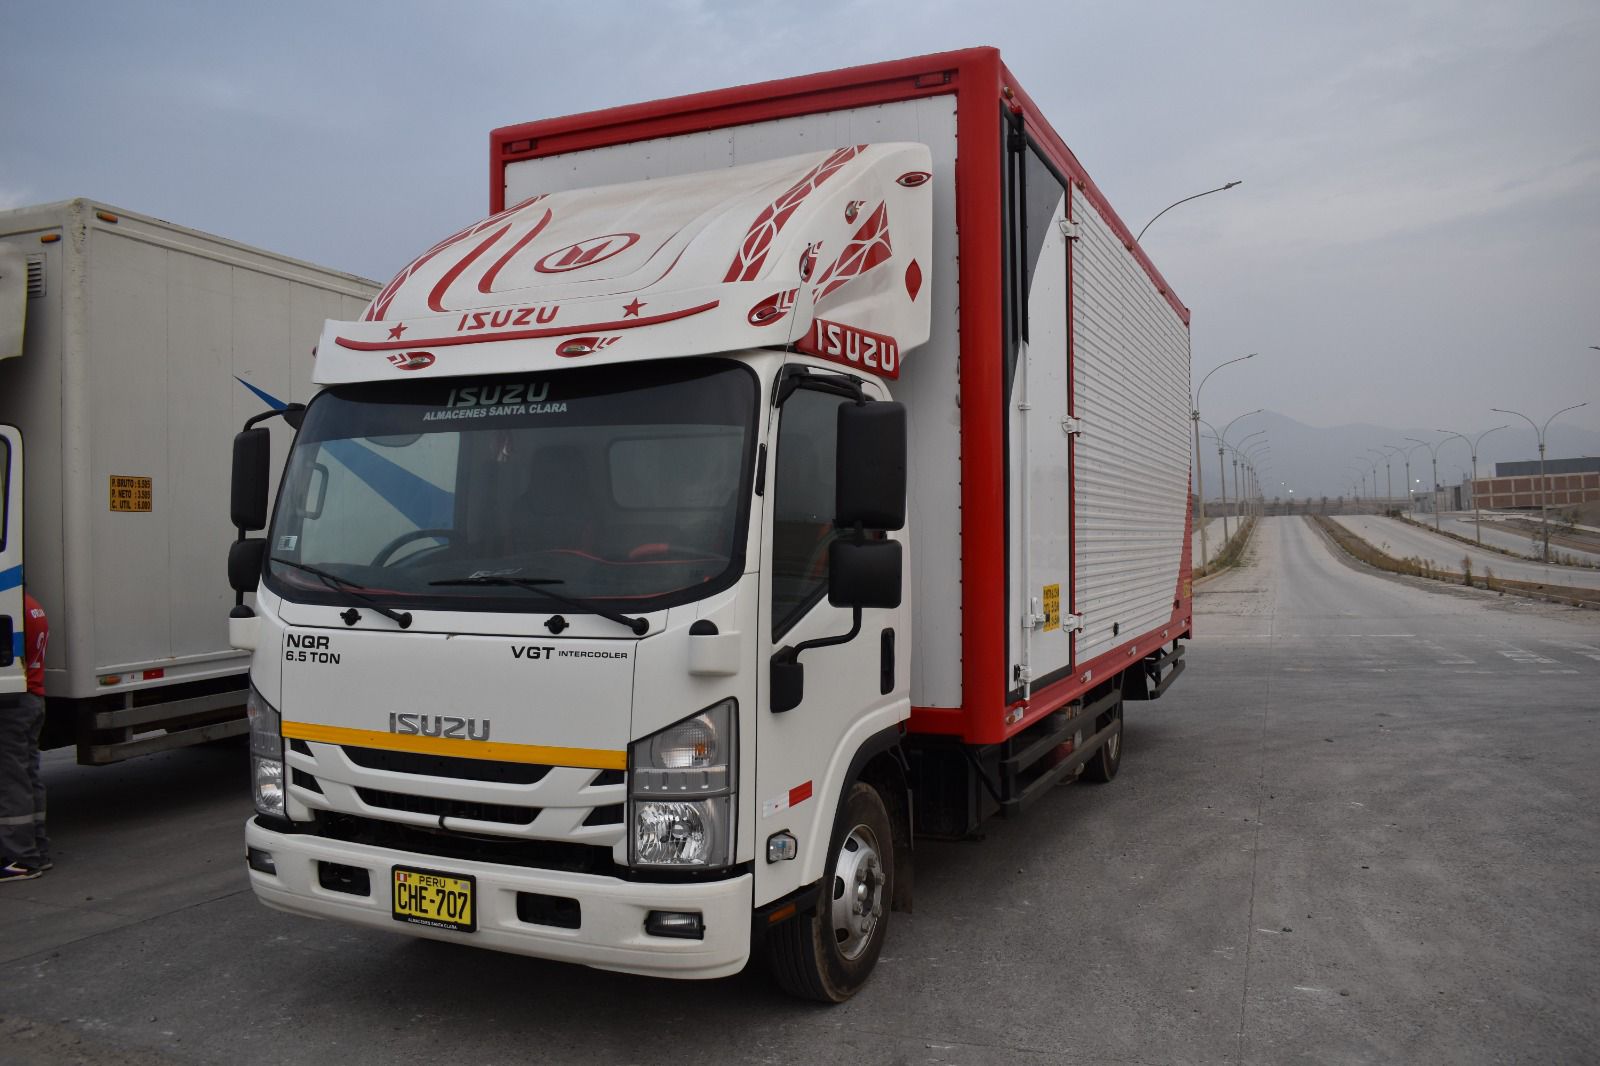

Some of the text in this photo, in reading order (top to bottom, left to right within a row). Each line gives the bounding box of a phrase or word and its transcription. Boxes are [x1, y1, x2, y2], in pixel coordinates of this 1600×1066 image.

[457, 305, 560, 331] ISUZU
[816, 319, 895, 372] ISUZU
[447, 382, 549, 408] ISUZU
[423, 403, 568, 421] ALMACENES SANTA CLARA
[286, 634, 330, 650] NQR
[511, 645, 628, 660] VGT INTERCOOLER
[285, 650, 341, 665] 6.5 TON
[389, 711, 491, 741] ISUZU
[419, 875, 446, 888] PERU
[397, 883, 468, 919] CHE-707
